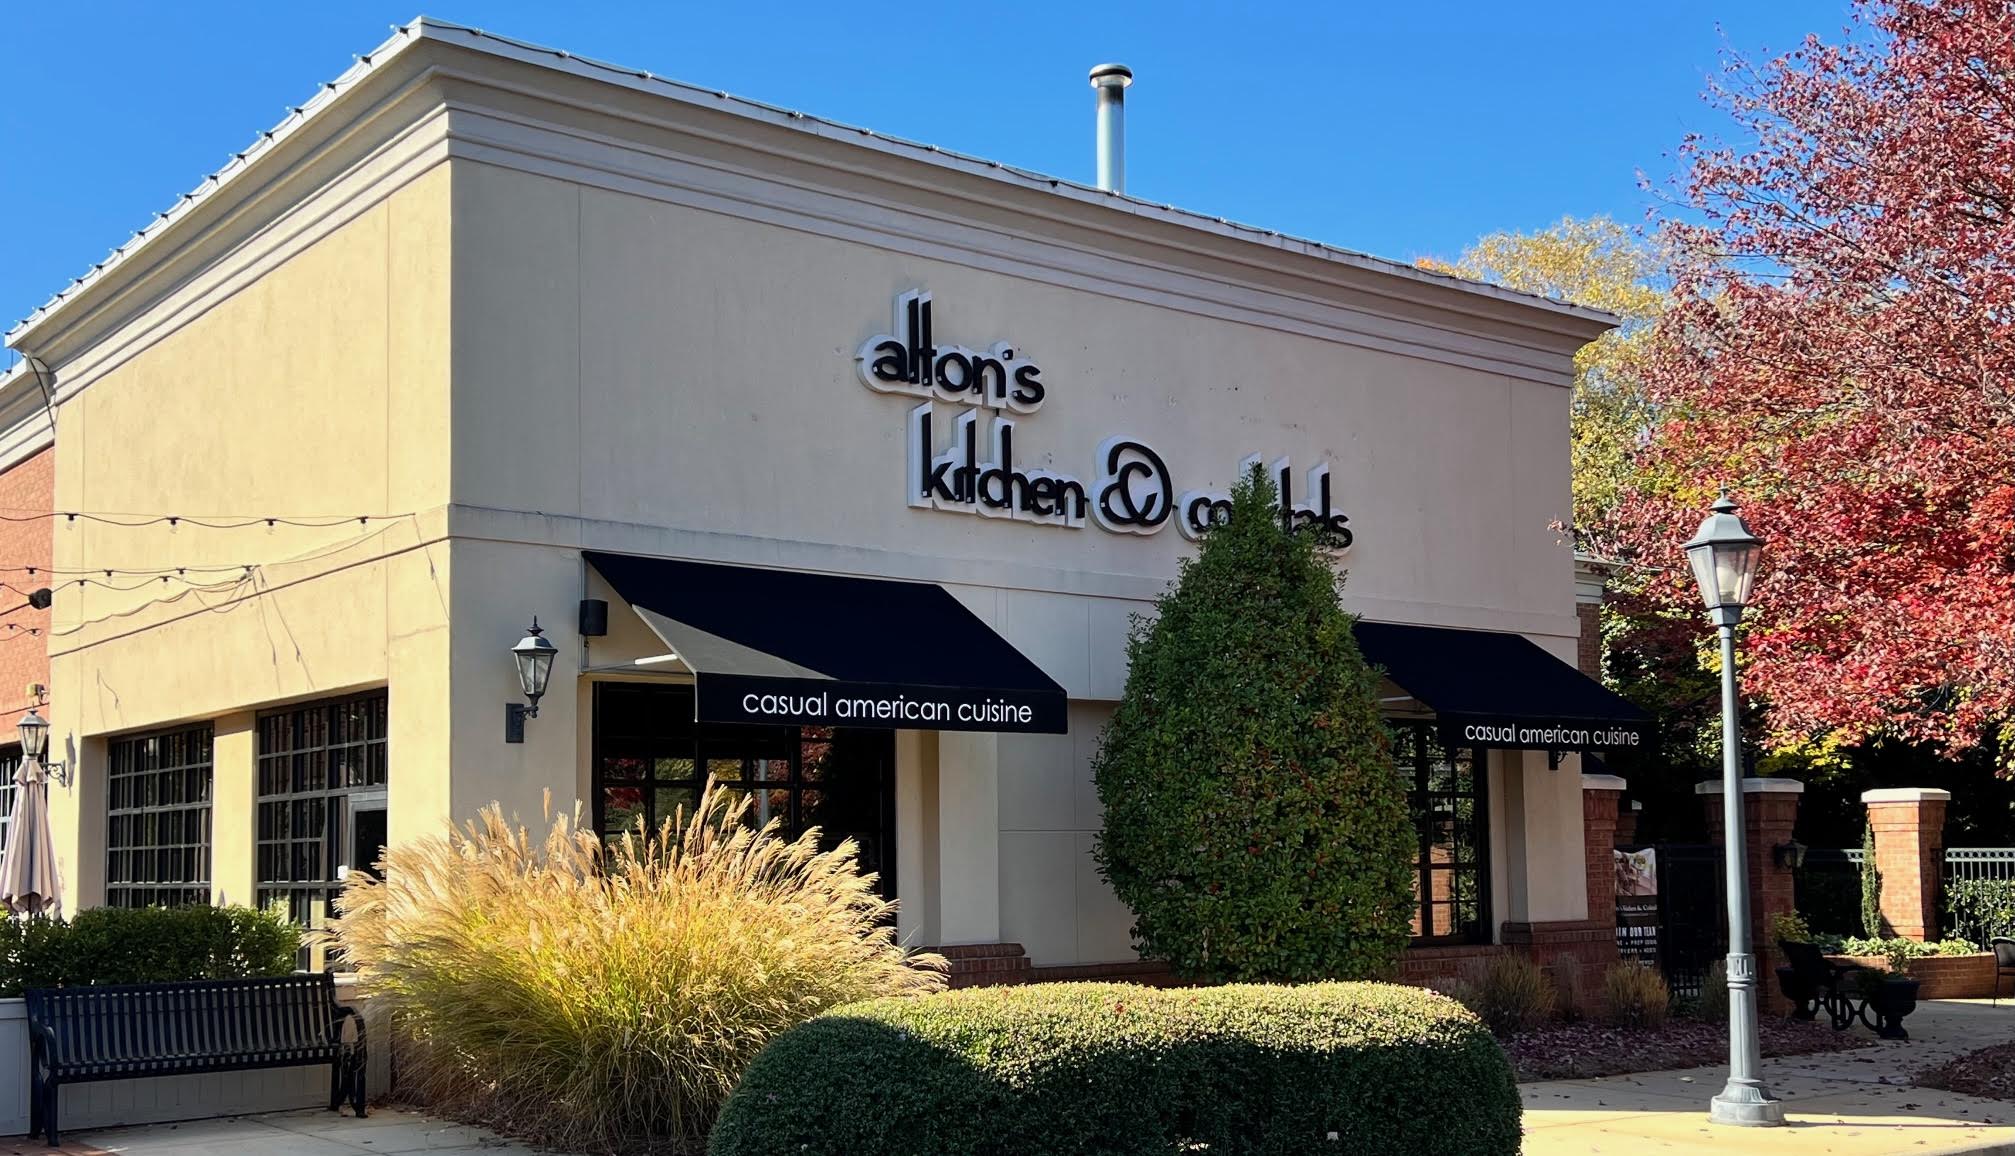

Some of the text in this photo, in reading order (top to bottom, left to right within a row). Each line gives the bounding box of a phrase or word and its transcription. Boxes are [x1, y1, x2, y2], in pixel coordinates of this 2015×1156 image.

[872, 297, 1045, 405] alton's
[921, 412, 1086, 518] kitchen
[742, 691, 1033, 723] casual american cuisine
[1464, 723, 1640, 746] casual american cuisine
